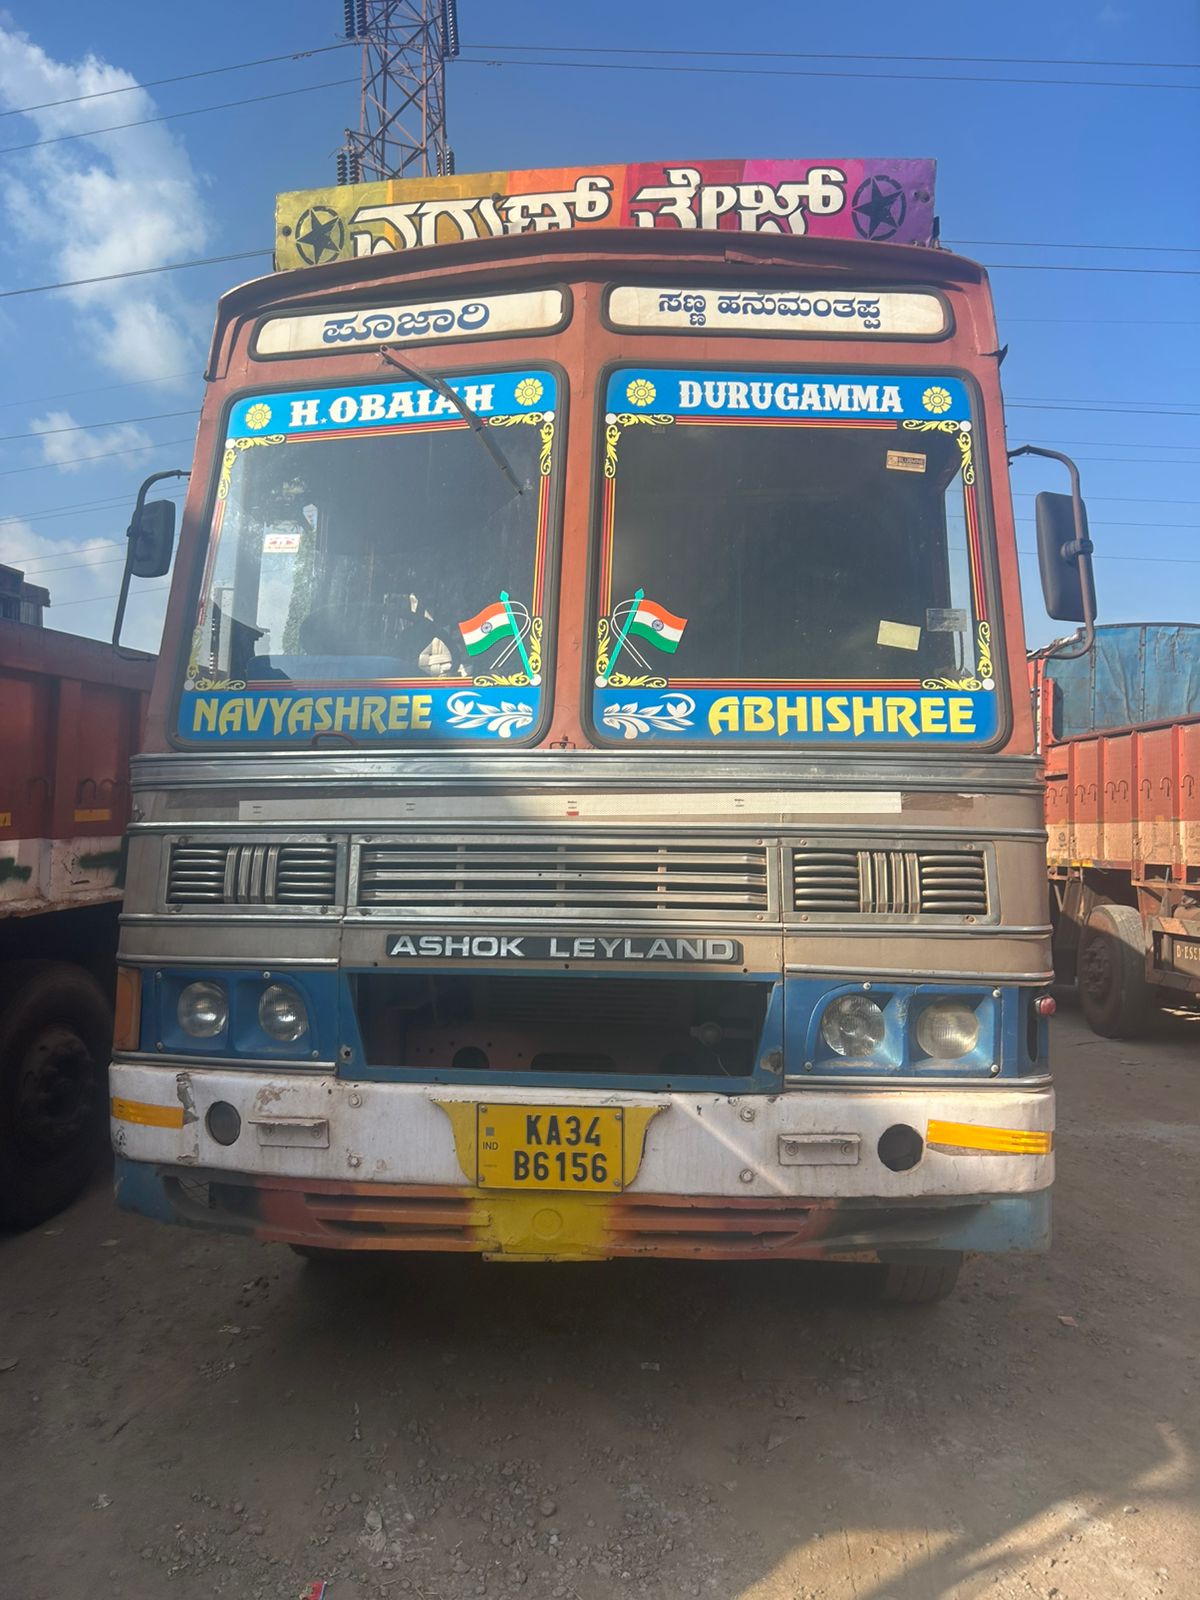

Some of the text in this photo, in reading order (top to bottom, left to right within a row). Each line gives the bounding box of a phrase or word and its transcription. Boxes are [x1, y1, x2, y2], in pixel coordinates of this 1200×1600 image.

[322, 303, 490, 344] ಪೂಜಾರಿ
[658, 290, 882, 330] ಸಣ್ಣ ಹನುಮಂತಪ್ಪ
[678, 380, 904, 413] DURUGAMMA
[192, 694, 433, 736] NAVYASHREE
[707, 695, 977, 737] ABHISHREE
[390, 935, 737, 961] ASHOK LEYLAND
[482, 1141, 499, 1151] IND
[526, 1114, 601, 1147] KA34
[513, 1150, 608, 1183] B6156
